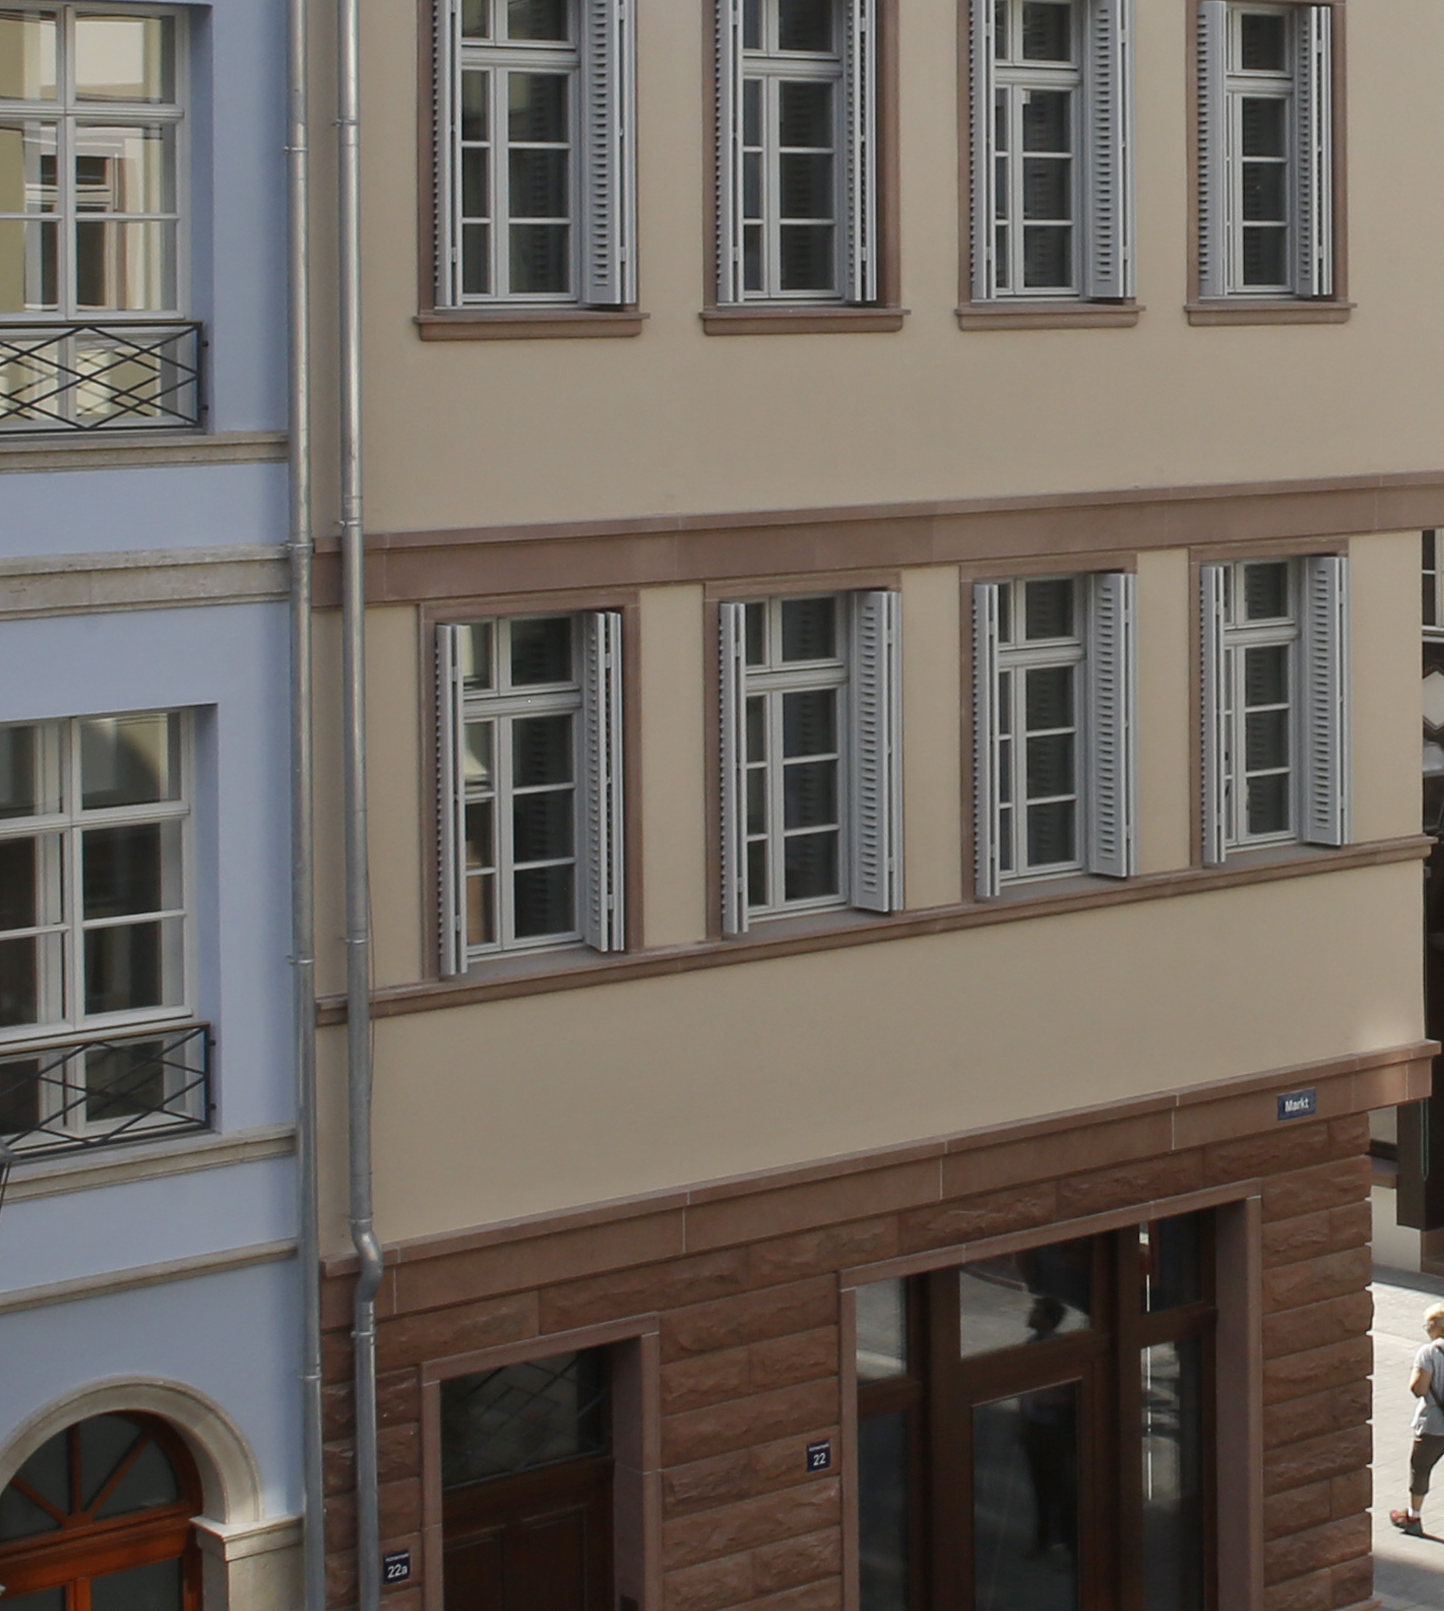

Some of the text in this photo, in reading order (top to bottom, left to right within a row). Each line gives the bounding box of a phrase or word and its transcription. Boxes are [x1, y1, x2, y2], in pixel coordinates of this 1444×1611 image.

[1285, 1097, 1309, 1112] Markt
[813, 1452, 826, 1466] 22
[387, 1564, 408, 1578] 22a
